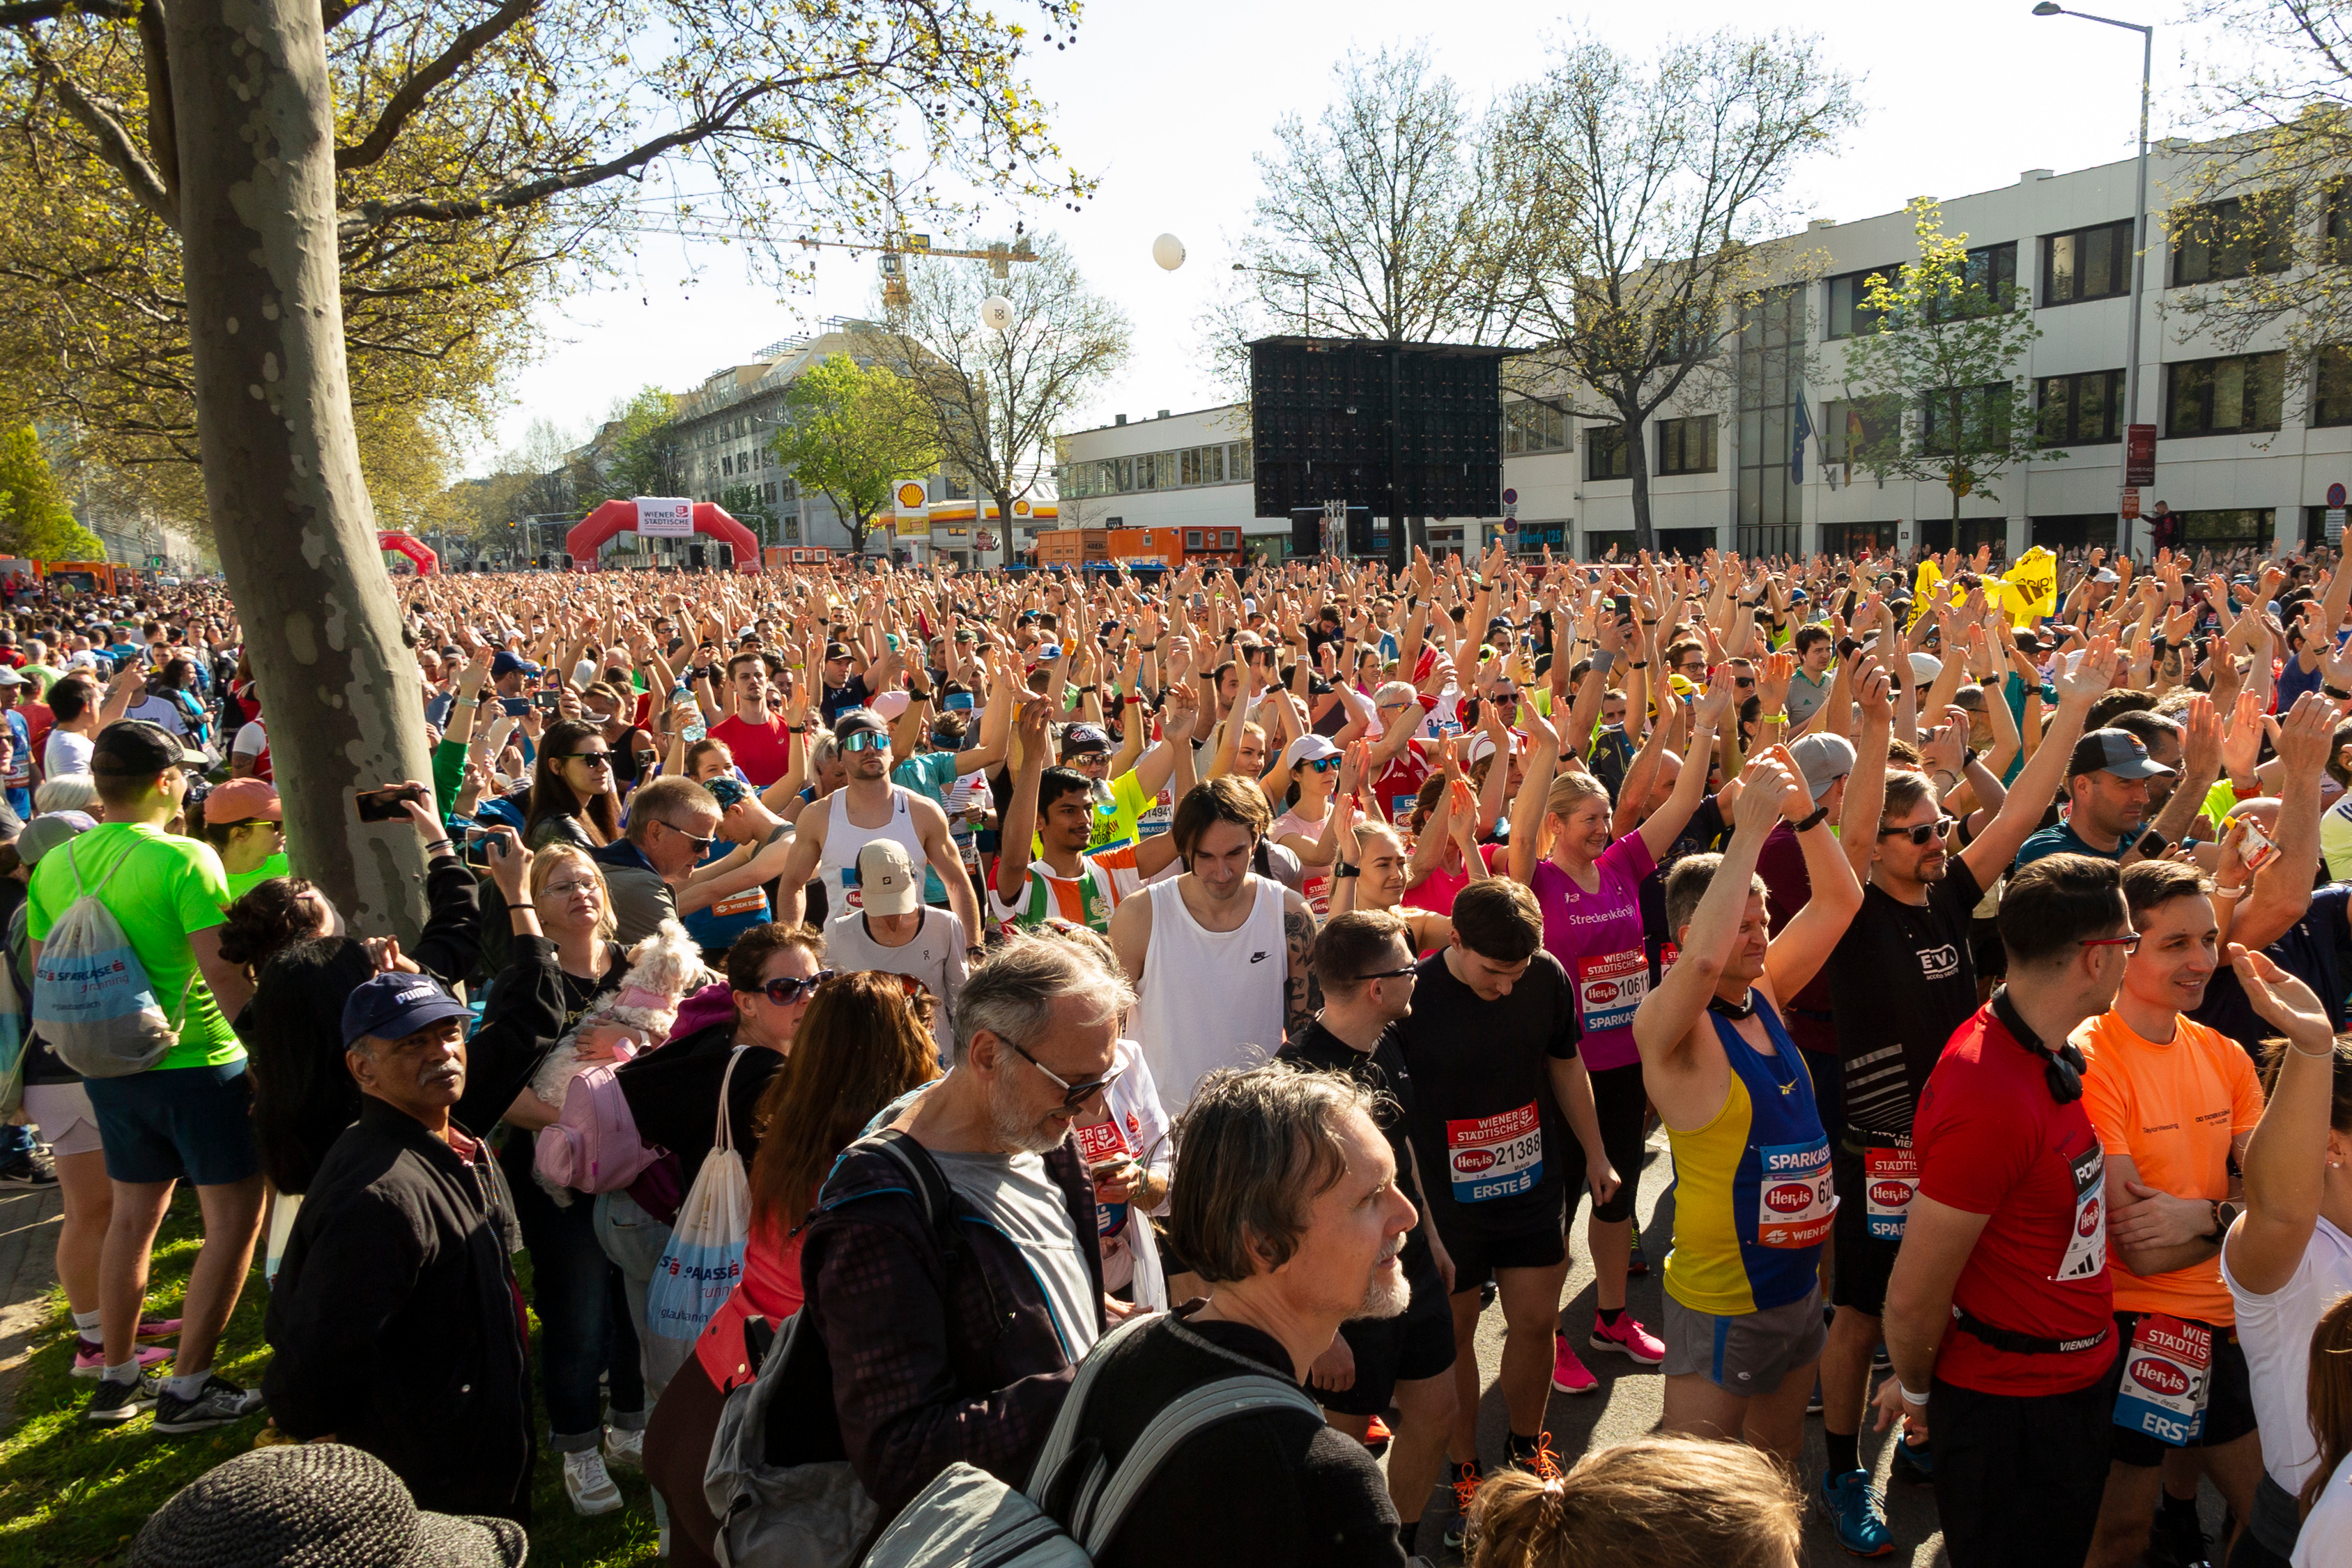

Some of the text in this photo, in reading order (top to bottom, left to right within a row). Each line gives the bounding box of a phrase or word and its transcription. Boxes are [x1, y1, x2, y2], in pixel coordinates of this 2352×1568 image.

[1519, 530, 1544, 546] Liberty
[1547, 530, 1561, 543] 125
[729, 901, 748, 910] WIEN
[1604, 950, 1634, 963] WIENER
[1588, 986, 1617, 999] Hervis
[1620, 973, 1650, 997] 10611
[1478, 1111, 1519, 1129] WIENER
[1457, 1121, 1519, 1142] STÄDTISCHE
[1457, 1155, 1493, 1168] Hervis
[1496, 1133, 1540, 1167] 21388
[1473, 1180, 1518, 1199] ERSTE
[1771, 1190, 1810, 1206] Hervis
[1873, 1187, 1909, 1201] Hervis
[2081, 1206, 2099, 1230] Hervis
[1792, 1227, 1819, 1240] WIEN
[2060, 1337, 2094, 1351] VIENNA
[2135, 1361, 2185, 1390] Hervis
